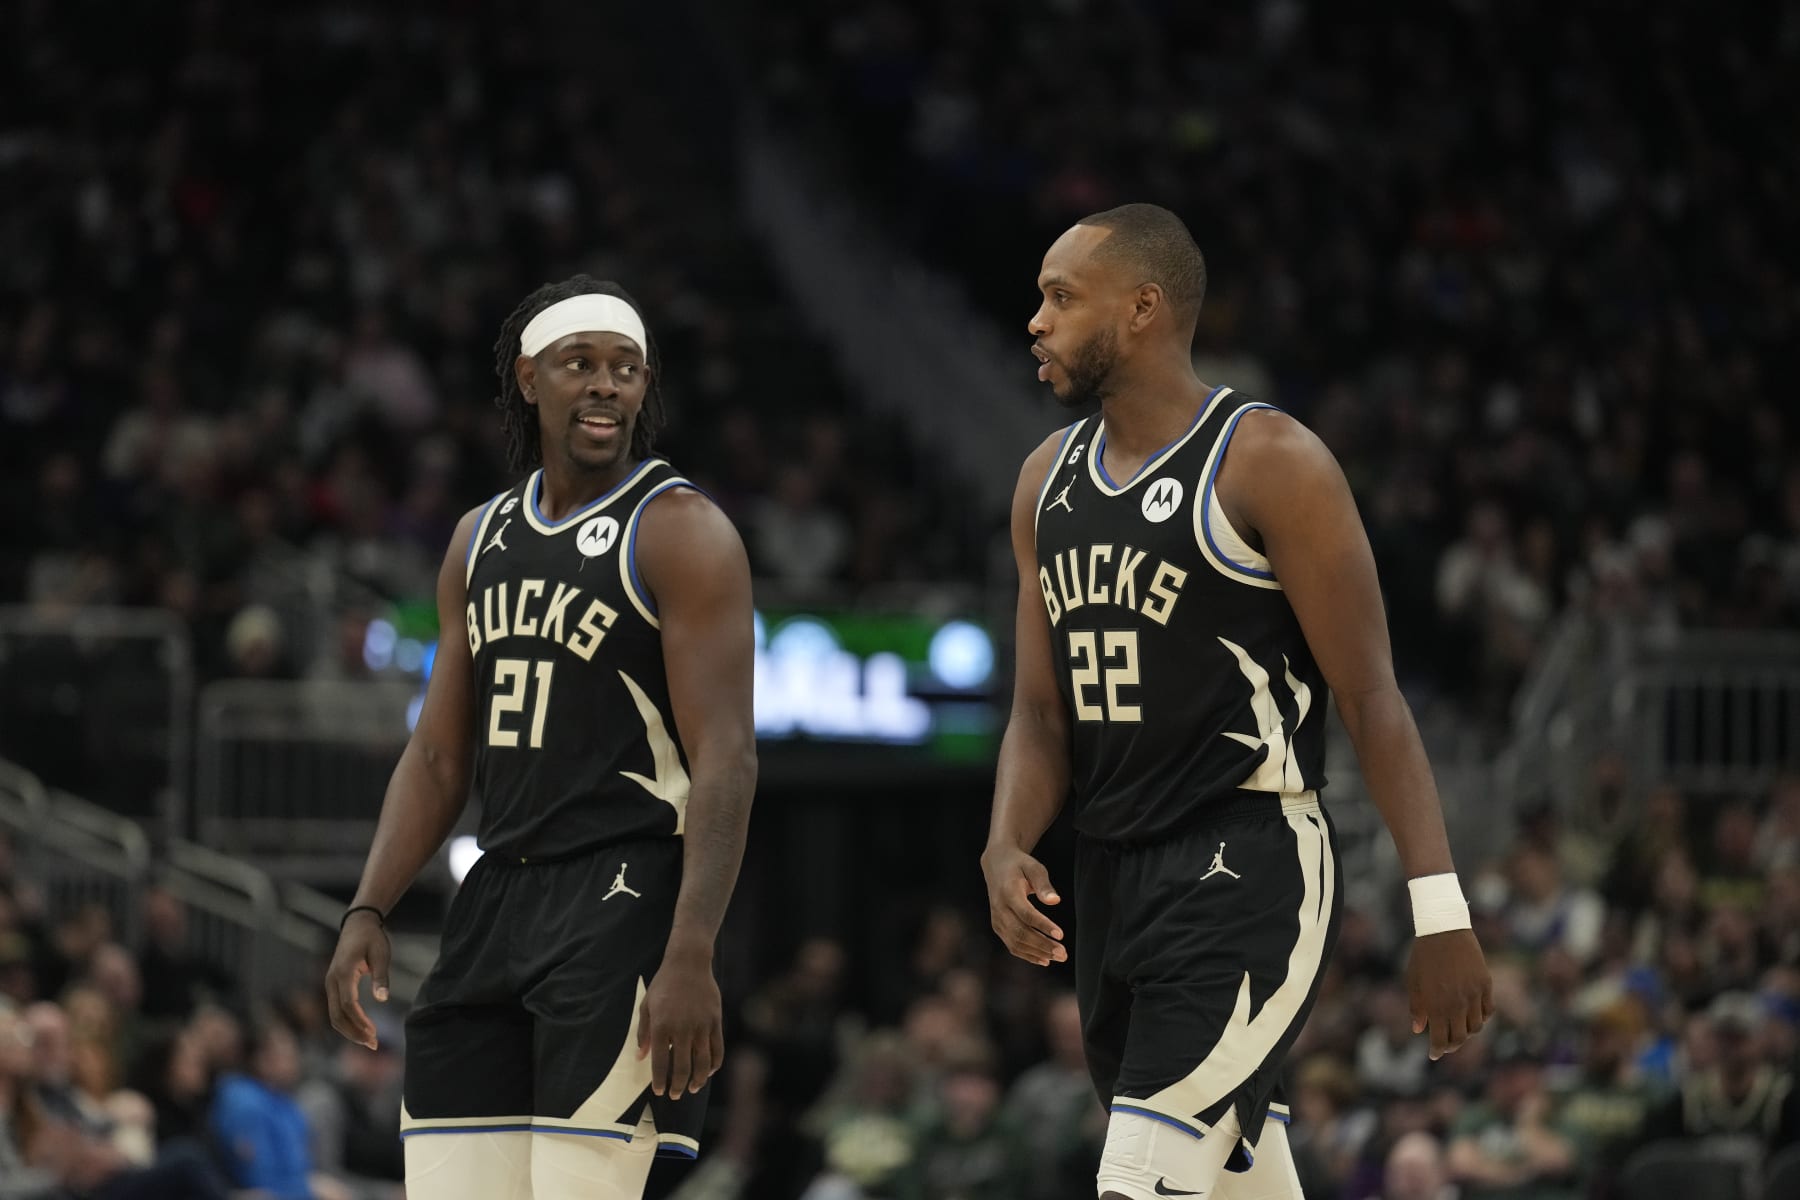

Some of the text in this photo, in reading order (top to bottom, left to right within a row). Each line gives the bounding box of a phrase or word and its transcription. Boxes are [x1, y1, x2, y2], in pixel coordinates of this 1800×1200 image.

[1068, 444, 1086, 465] 6
[466, 578, 619, 662] BUCKS
[1039, 544, 1188, 628] BUCKS
[488, 658, 554, 749] 21
[1068, 630, 1142, 722] 22
